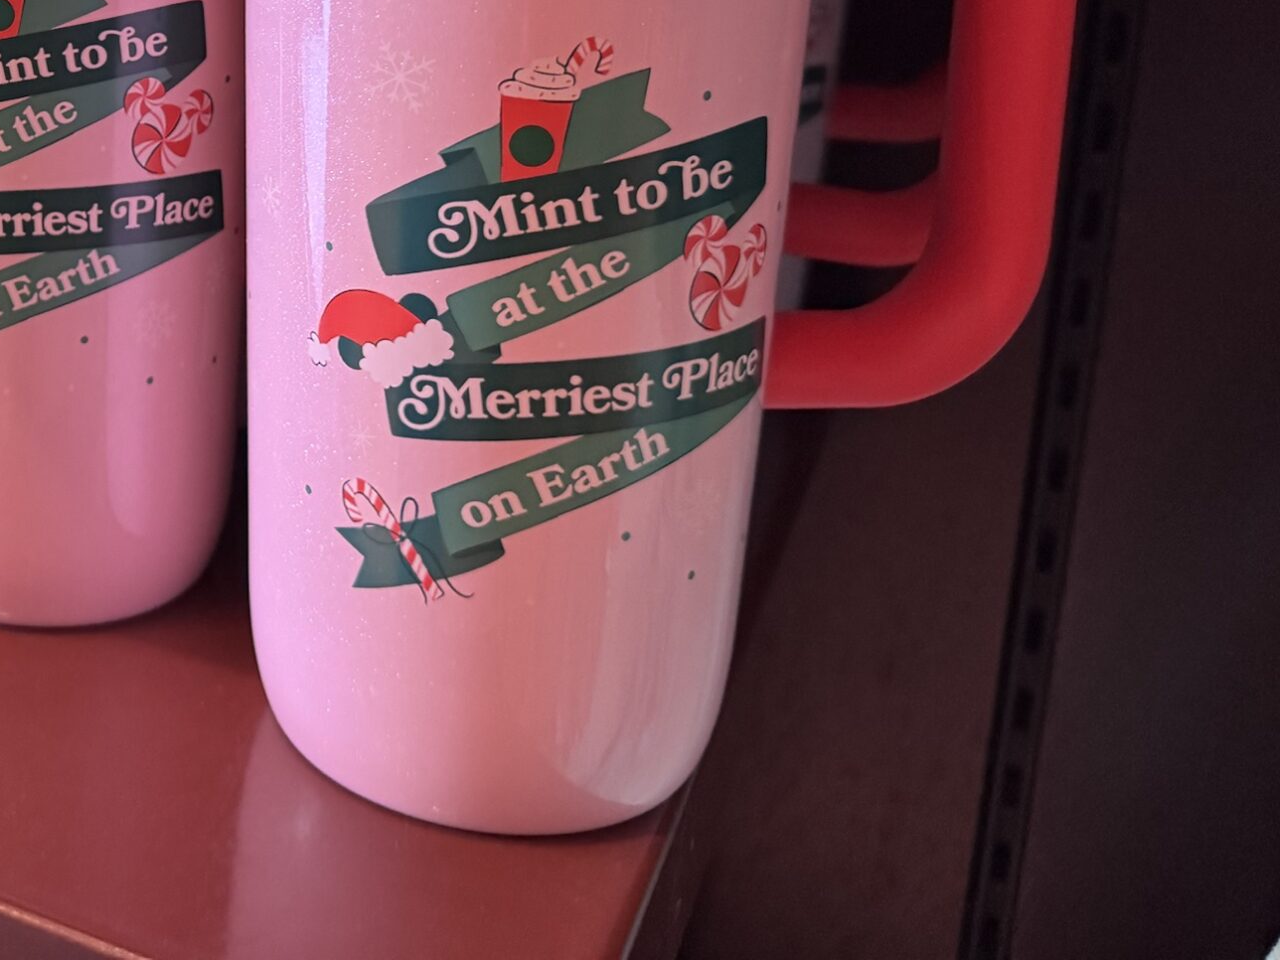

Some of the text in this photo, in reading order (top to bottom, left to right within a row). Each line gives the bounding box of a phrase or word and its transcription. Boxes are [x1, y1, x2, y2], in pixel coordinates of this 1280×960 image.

[63, 42, 107, 73] to
[98, 26, 168, 63] be
[13, 100, 78, 146] the
[110, 193, 214, 230] Place
[428, 155, 734, 258] Mint to be
[1, 247, 120, 310] Earth
[492, 249, 631, 327] at the
[398, 347, 758, 430] Merriest Place
[460, 427, 670, 528] on Earth
